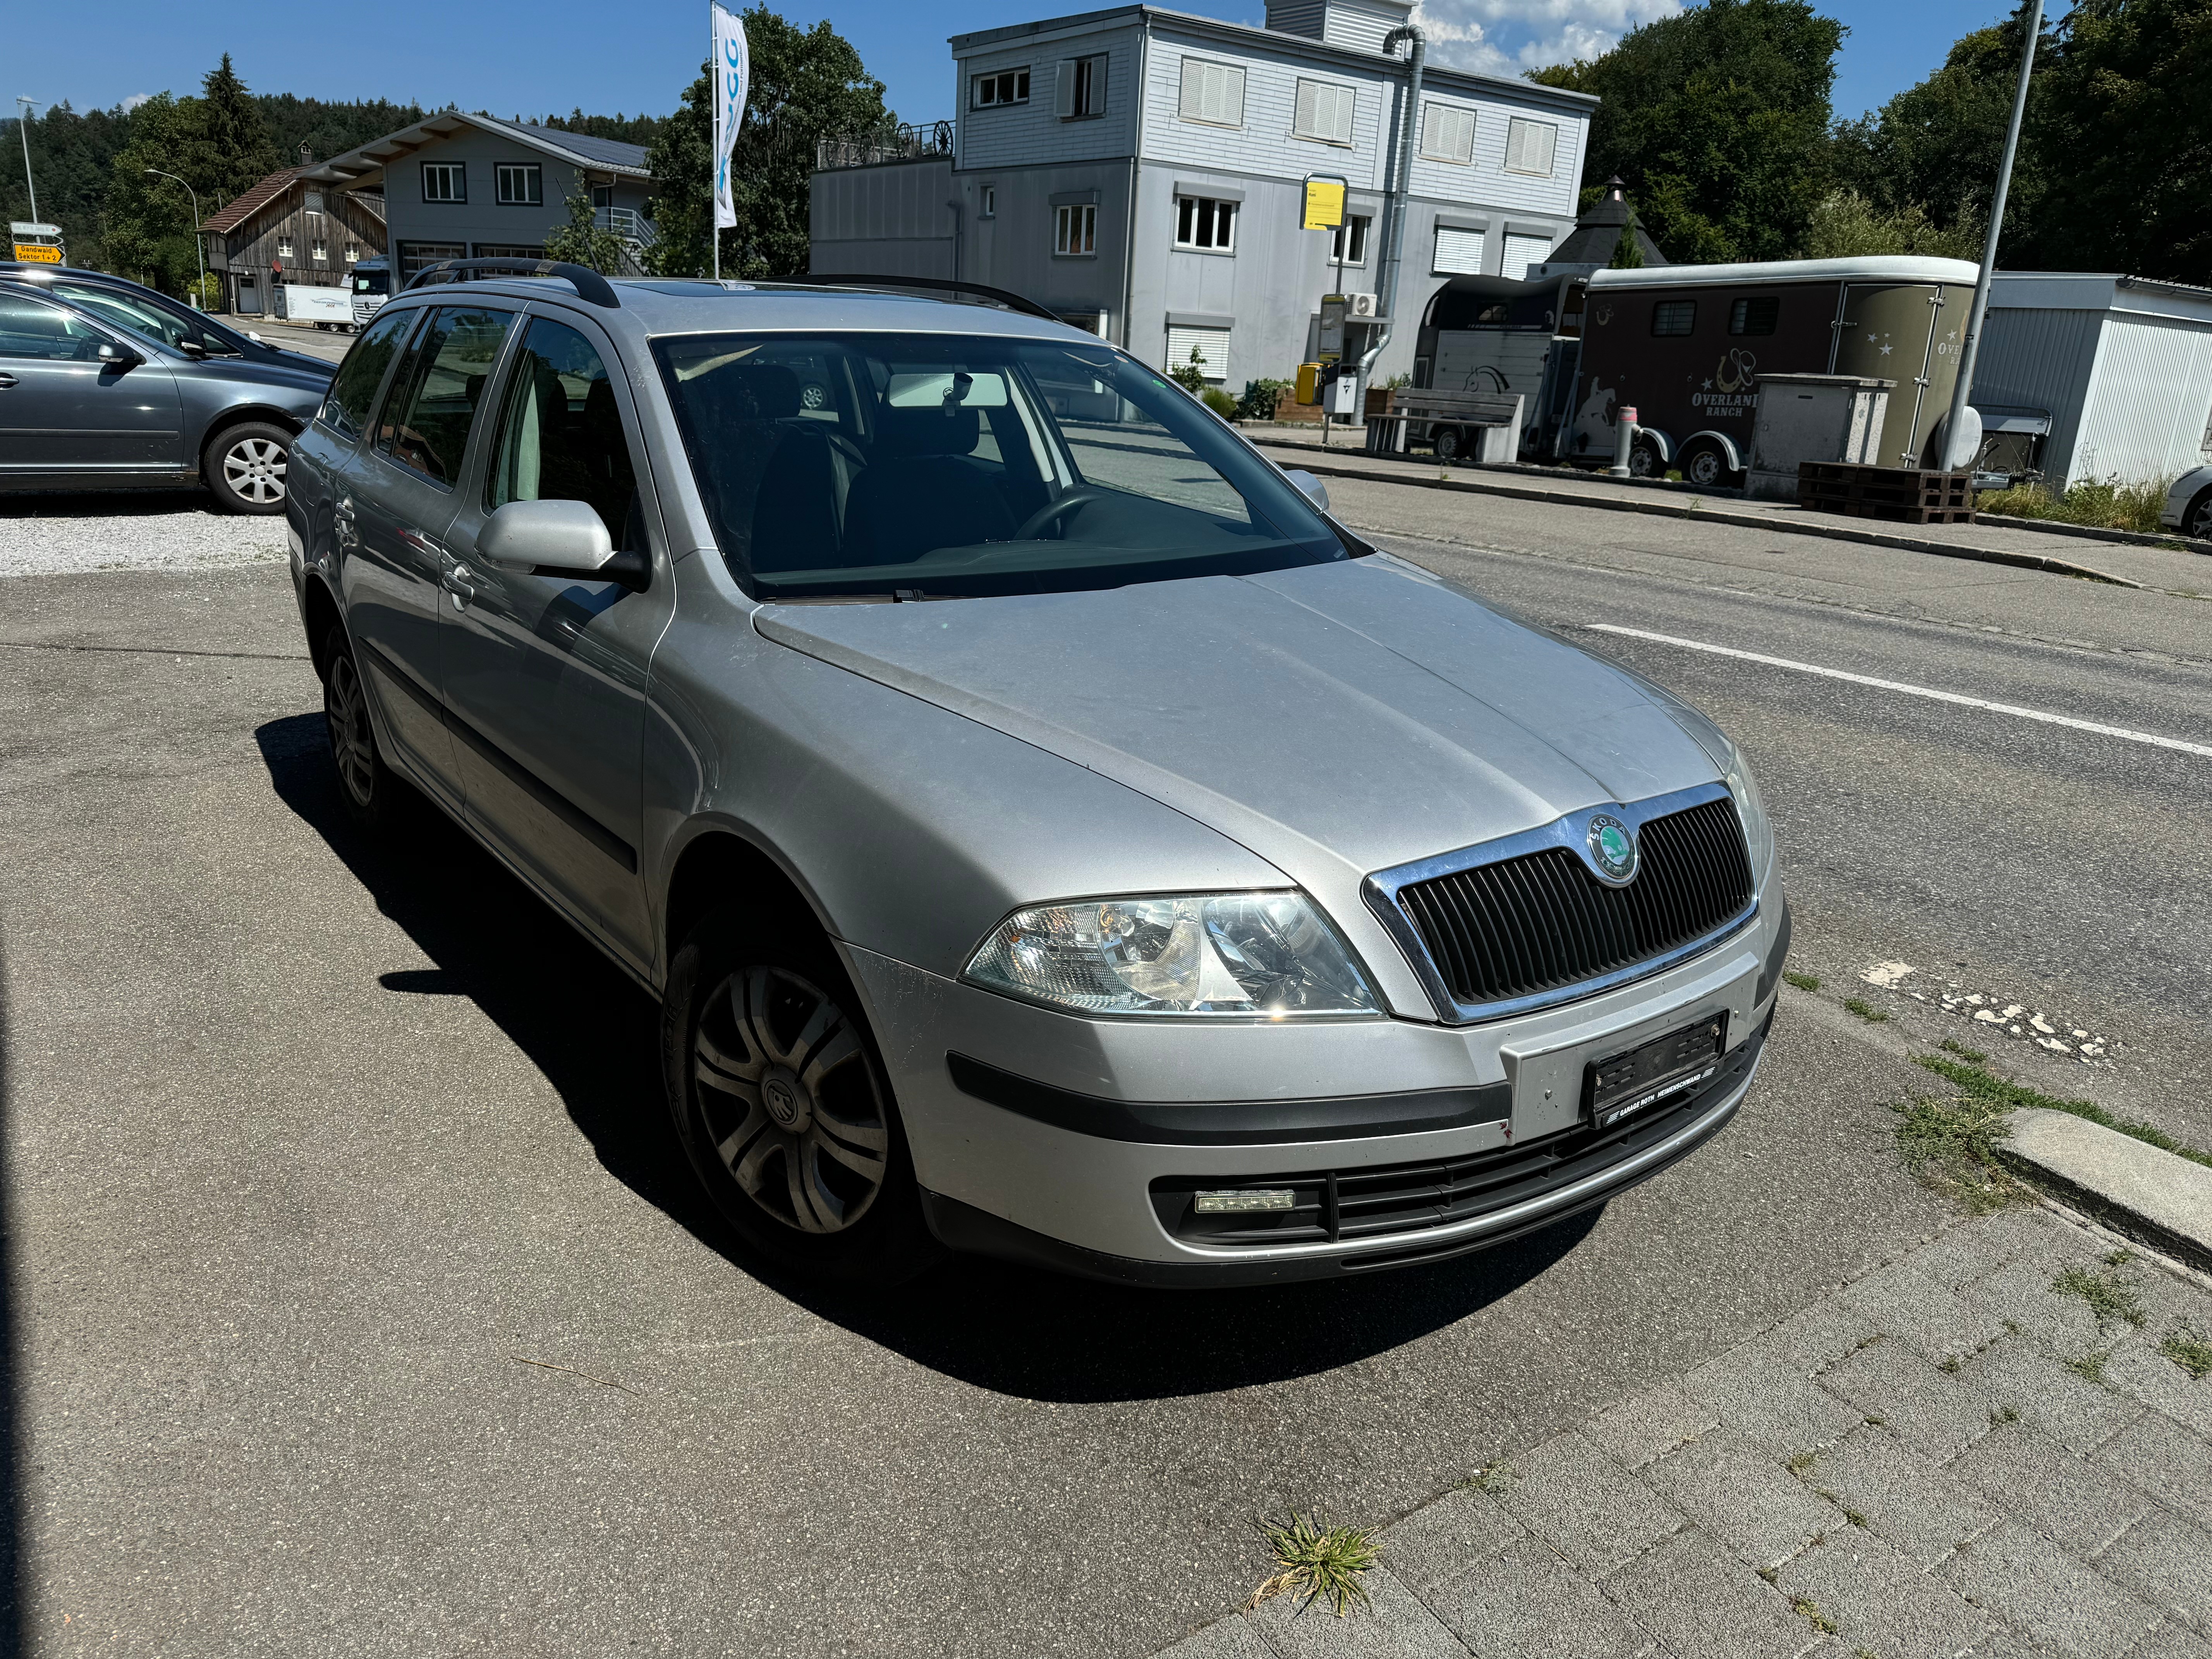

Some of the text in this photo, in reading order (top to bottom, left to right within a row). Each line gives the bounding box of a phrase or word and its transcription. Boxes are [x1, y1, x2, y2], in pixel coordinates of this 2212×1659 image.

[1706, 407, 1743, 417] RANCH
[1620, 1074, 1701, 1116] GARAGE ROTH HEIMENSCHWAND
